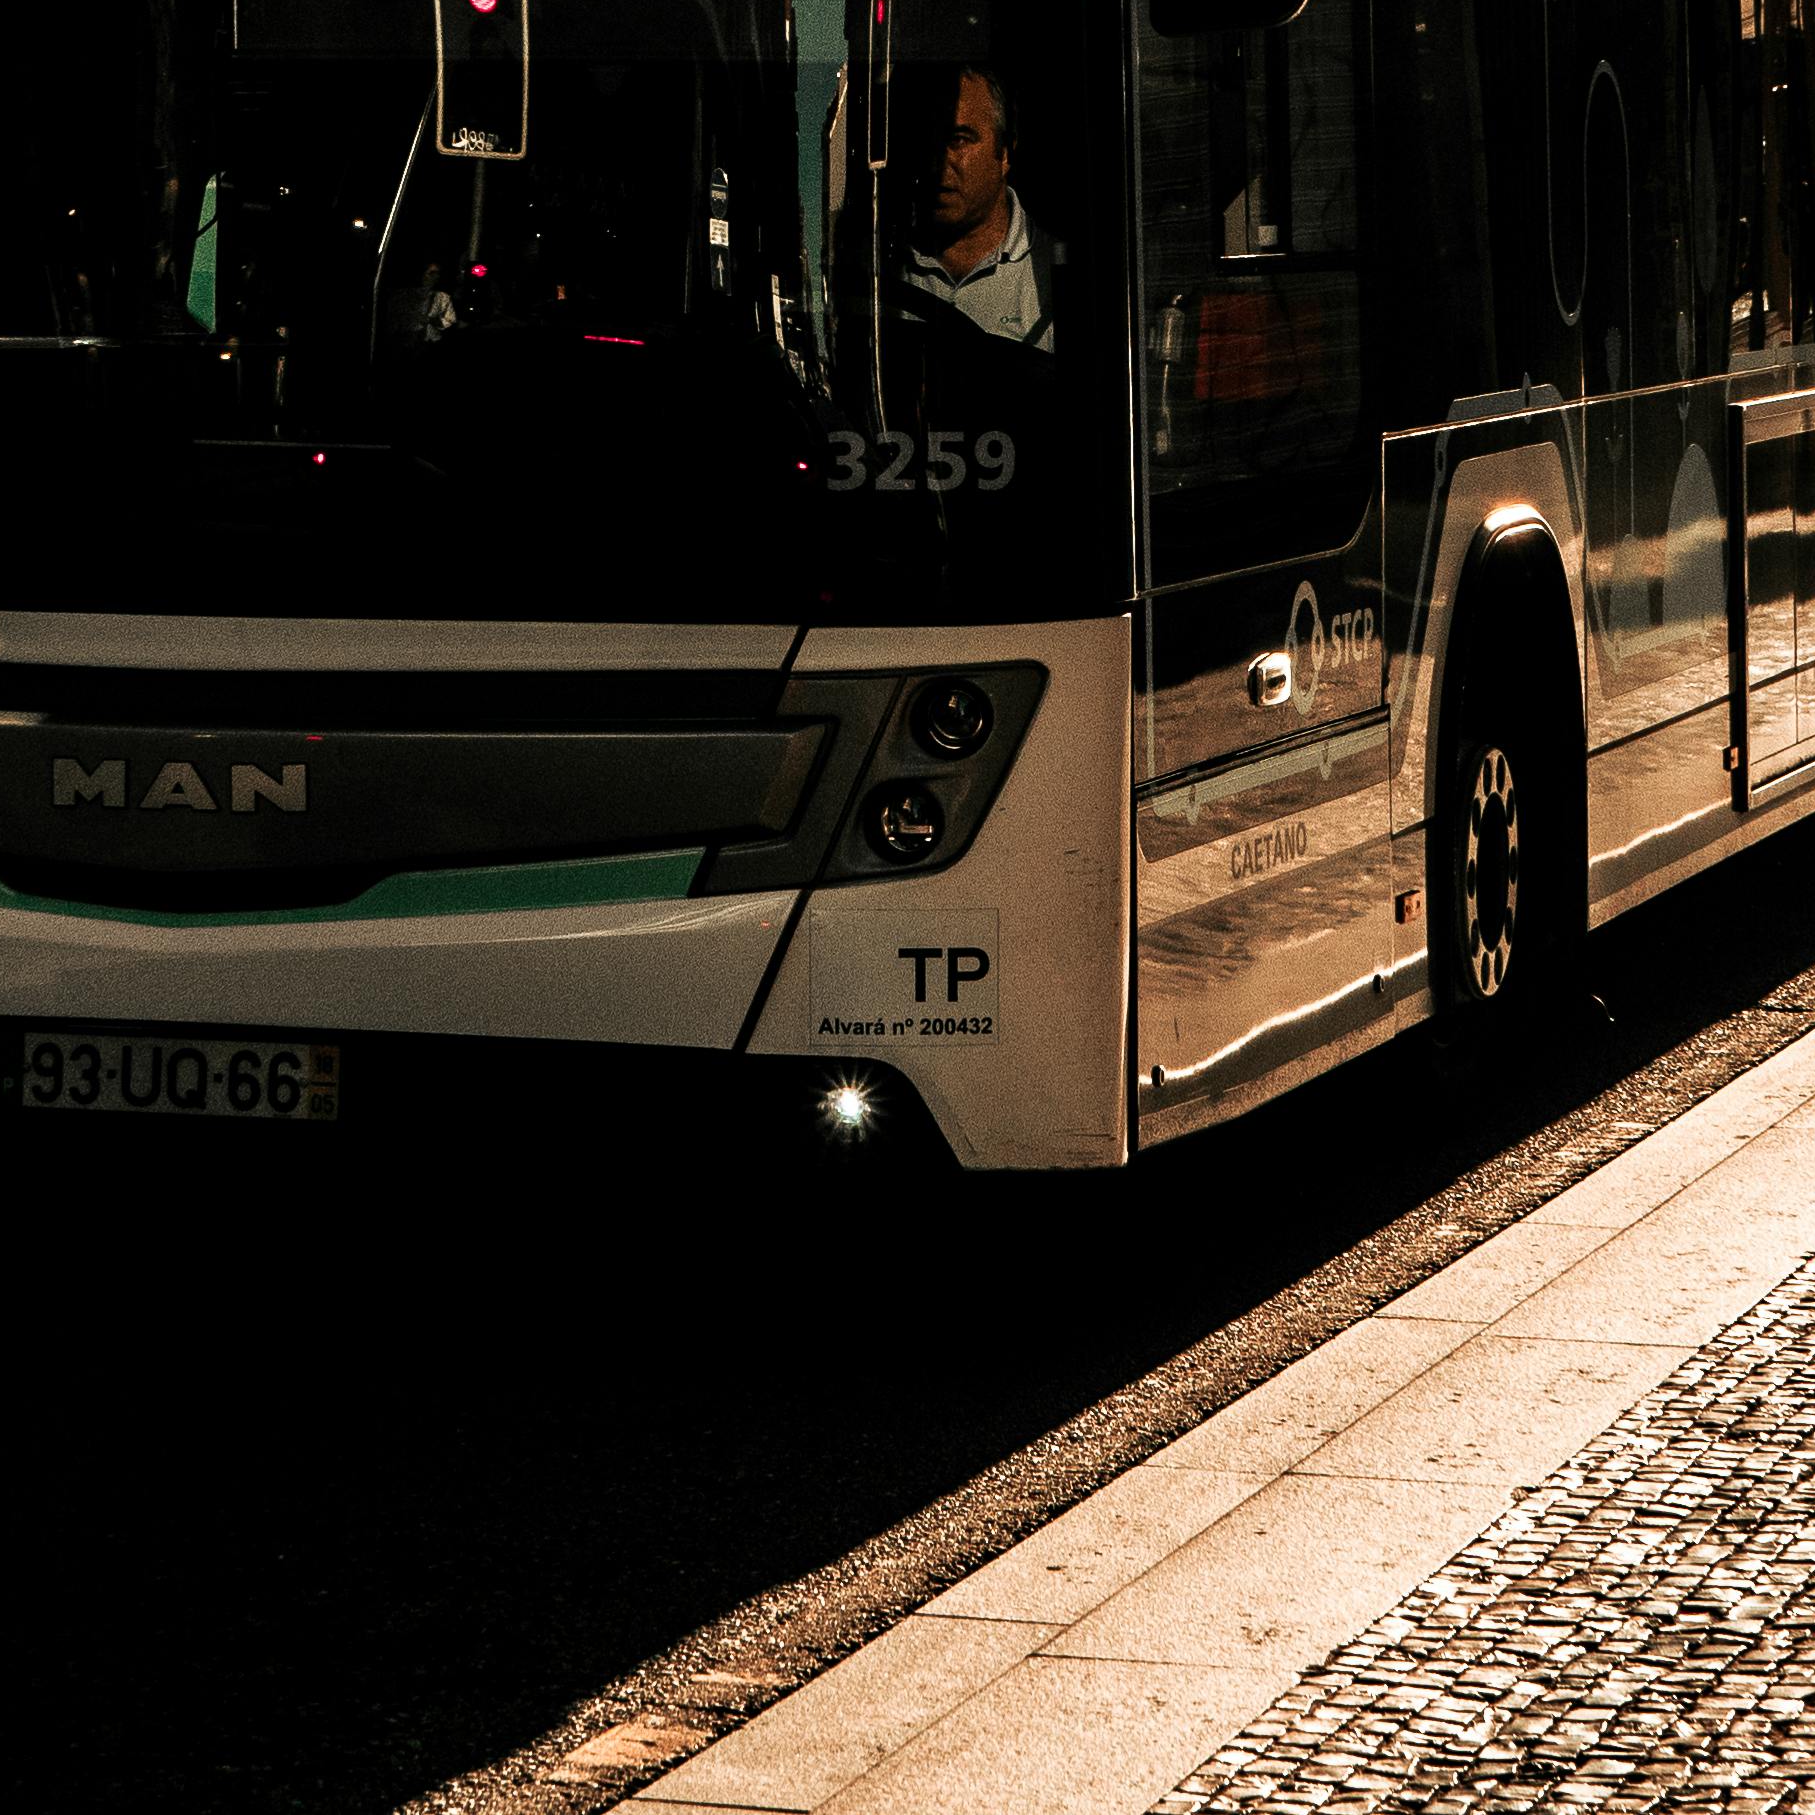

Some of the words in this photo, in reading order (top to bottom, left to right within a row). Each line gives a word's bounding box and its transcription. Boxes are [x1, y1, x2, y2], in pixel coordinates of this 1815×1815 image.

[827, 430, 1016, 492] 3259
[1331, 607, 1374, 668] STCP
[53, 757, 308, 813] MAN
[1231, 821, 1307, 880] CAETANO
[898, 947, 990, 1003] TP
[818, 1017, 886, 1035] Alvará
[892, 1018, 914, 1035] nº
[920, 1016, 993, 1035] 200432
